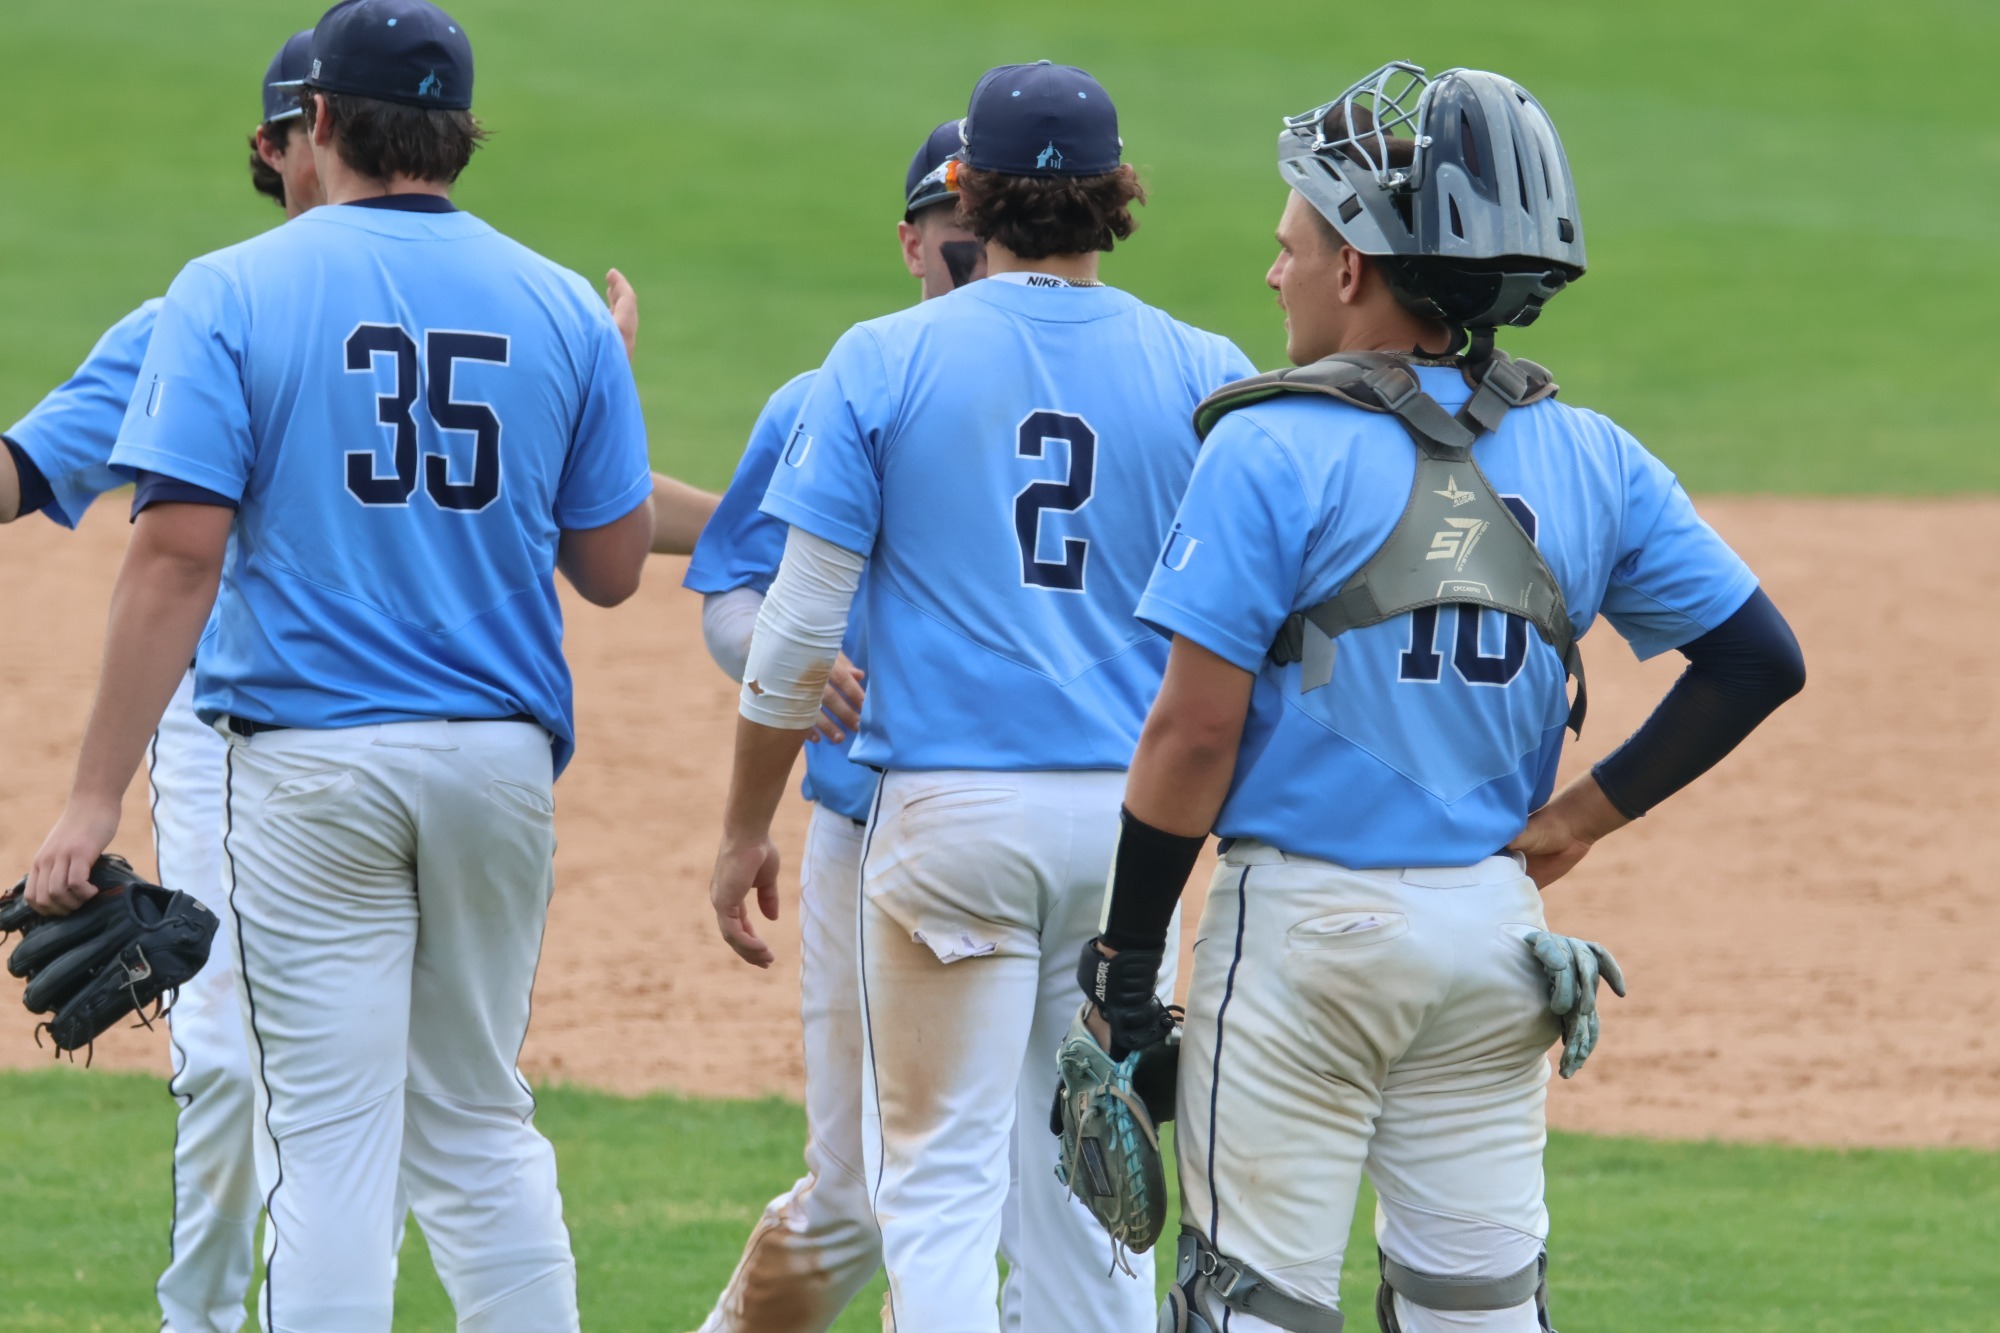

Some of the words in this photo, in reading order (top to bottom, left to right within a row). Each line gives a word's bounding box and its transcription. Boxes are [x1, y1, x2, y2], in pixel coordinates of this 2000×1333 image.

[1026, 275, 1061, 287] NIKE
[344, 322, 511, 513] 35
[1013, 408, 1097, 593] 2
